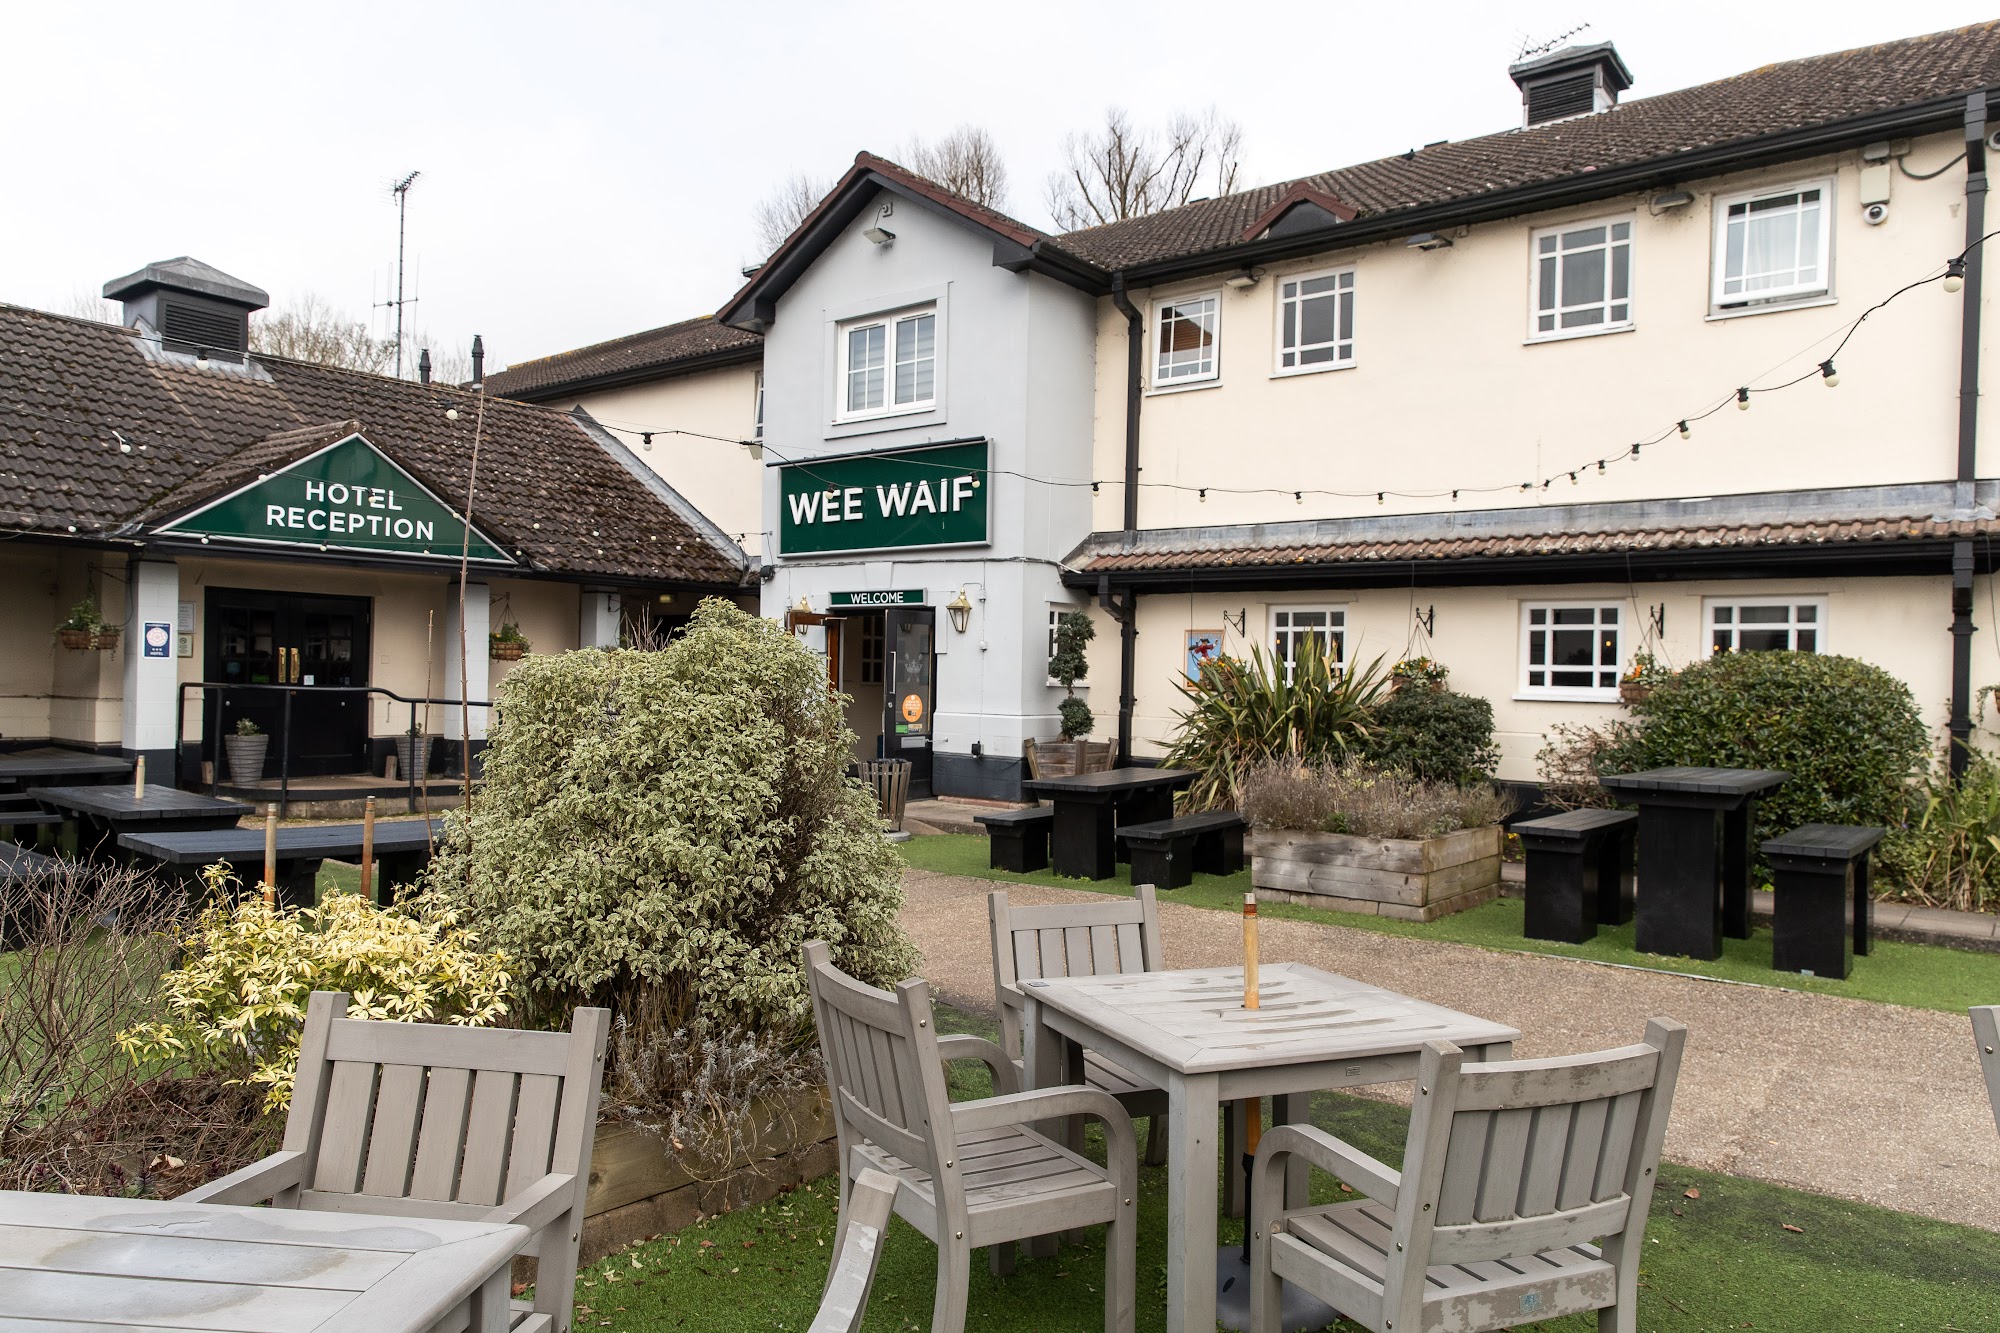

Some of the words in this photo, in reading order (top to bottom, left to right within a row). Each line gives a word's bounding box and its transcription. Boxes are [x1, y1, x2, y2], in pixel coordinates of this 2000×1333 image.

[305, 480, 402, 511] HOTEL
[788, 487, 863, 525] WEE
[875, 475, 974, 518] WAIF
[266, 504, 433, 541] RECEPTION
[850, 591, 904, 604] WELCOME
